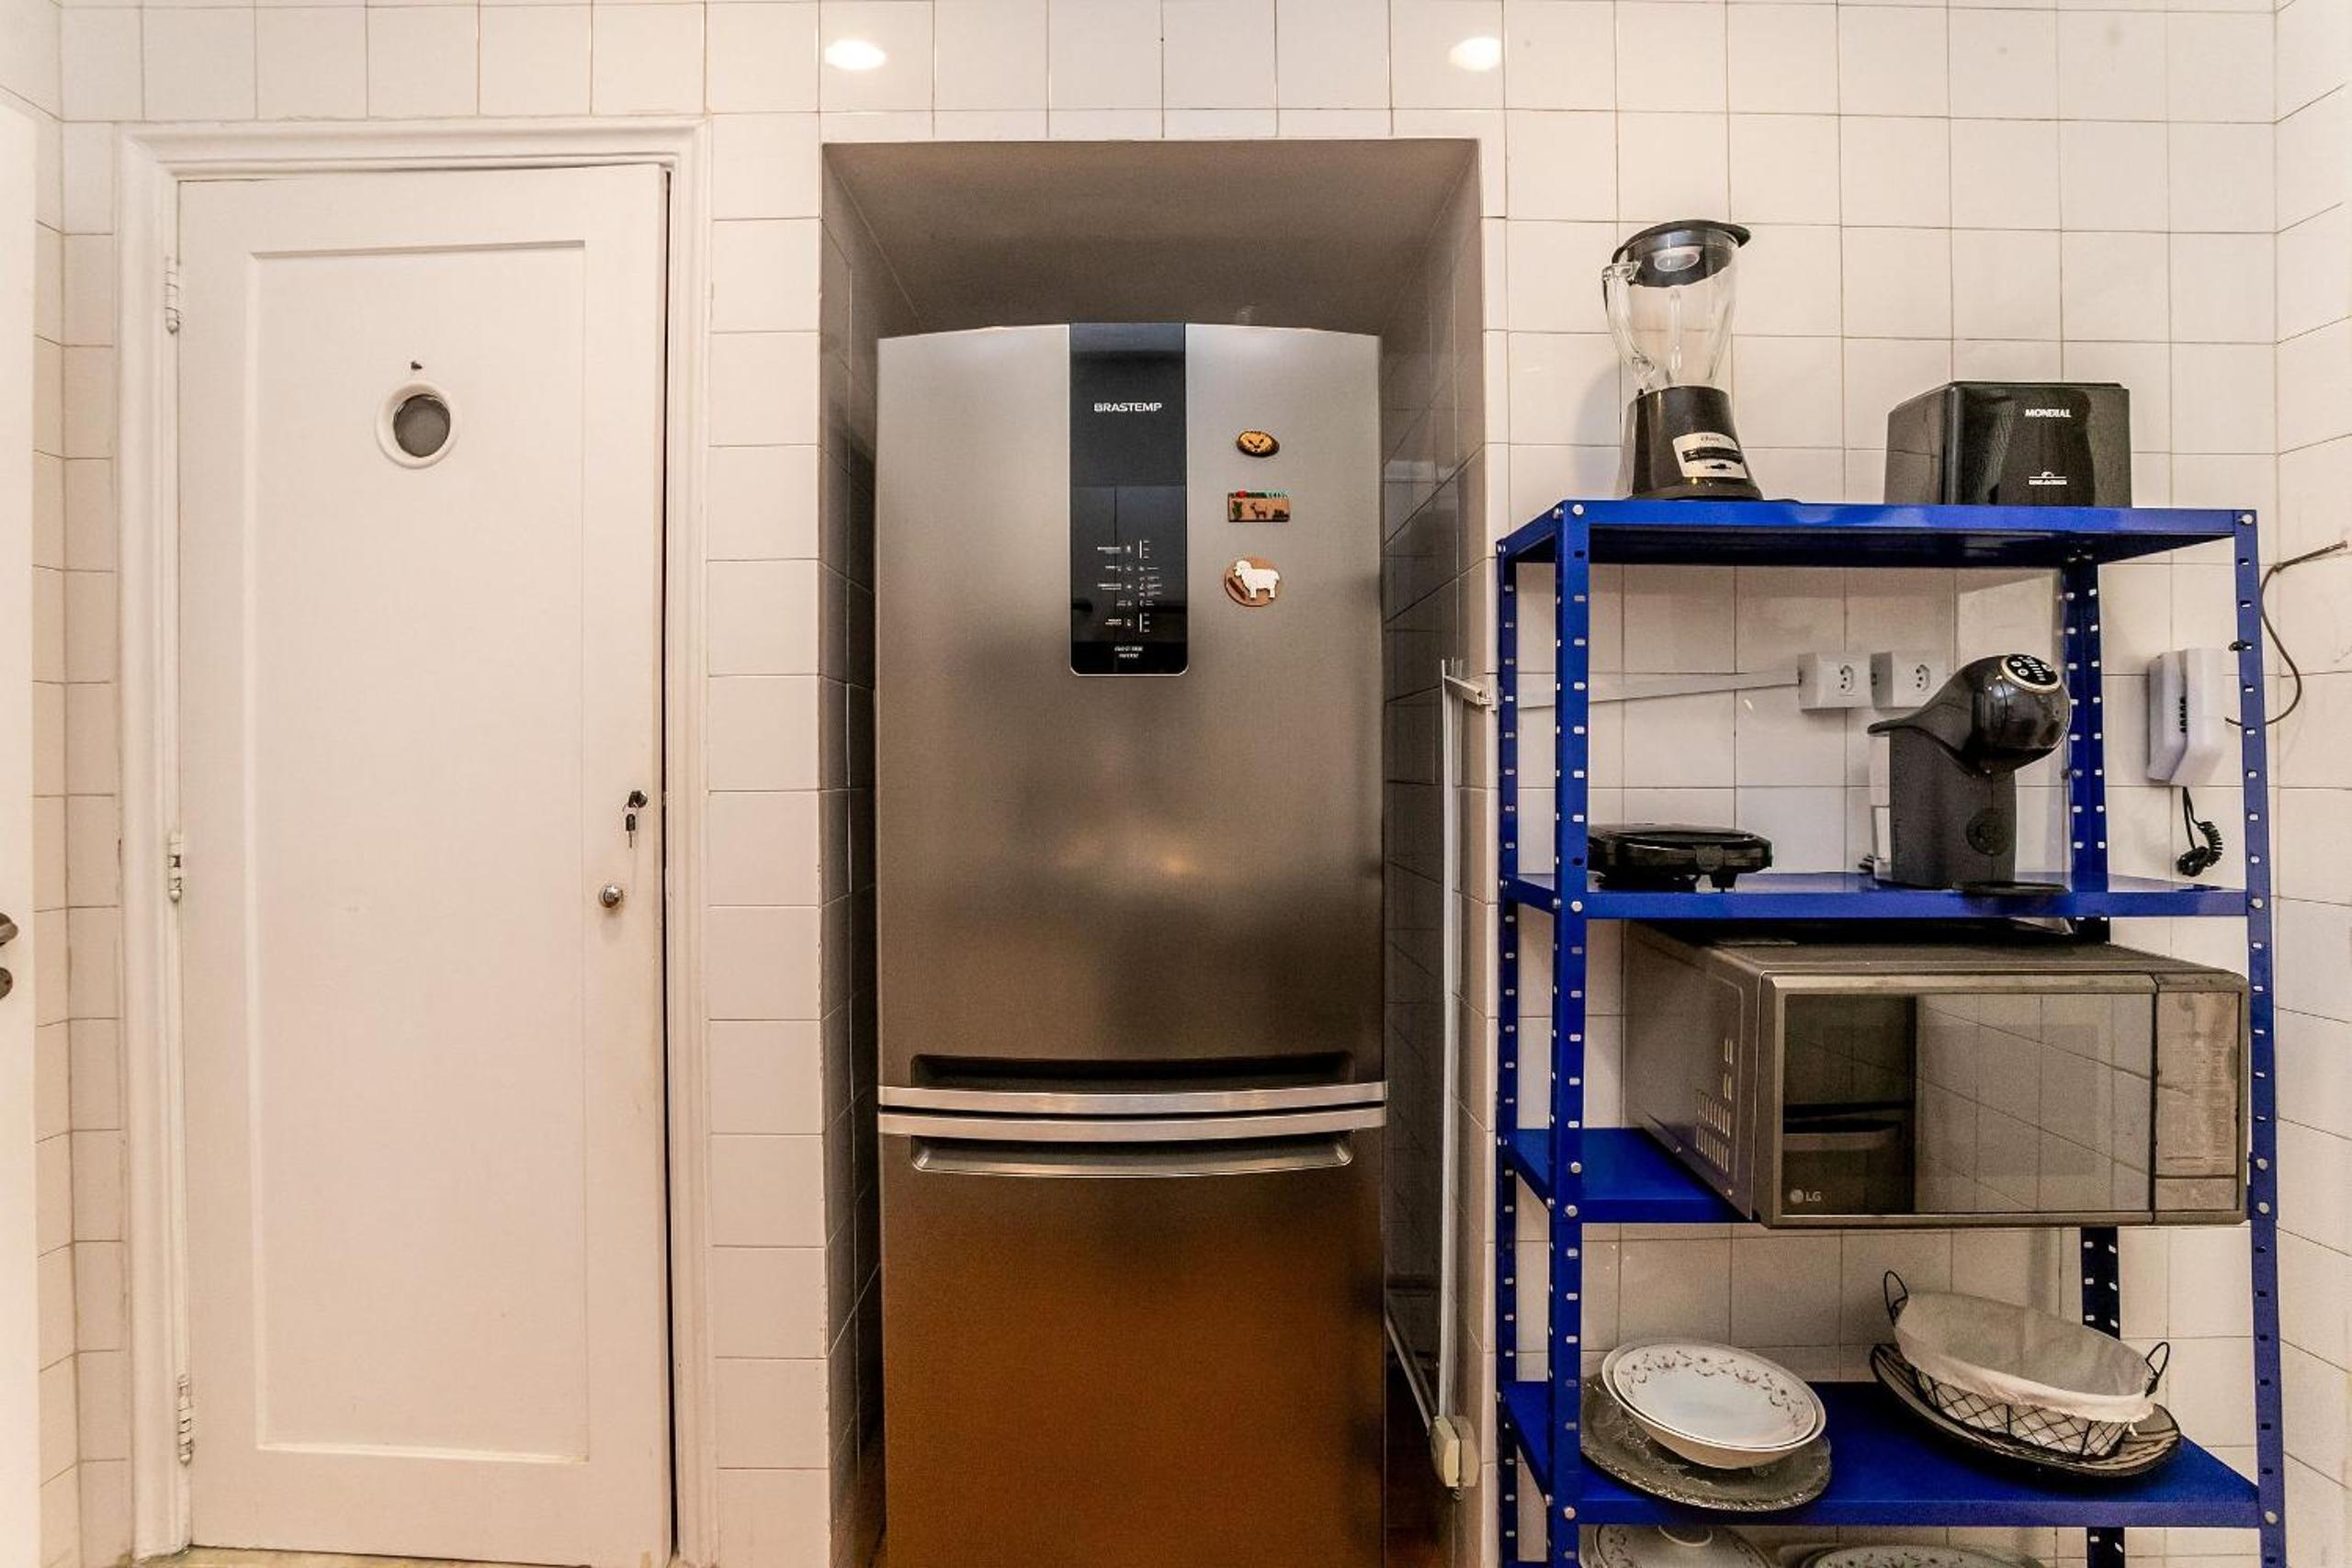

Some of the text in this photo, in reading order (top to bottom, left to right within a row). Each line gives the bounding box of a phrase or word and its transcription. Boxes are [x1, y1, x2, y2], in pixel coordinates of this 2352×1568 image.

[1093, 402, 1162, 412] BRASTEMP
[2025, 409, 2072, 418] MONDIAL
[1805, 1190, 1822, 1202] LG
